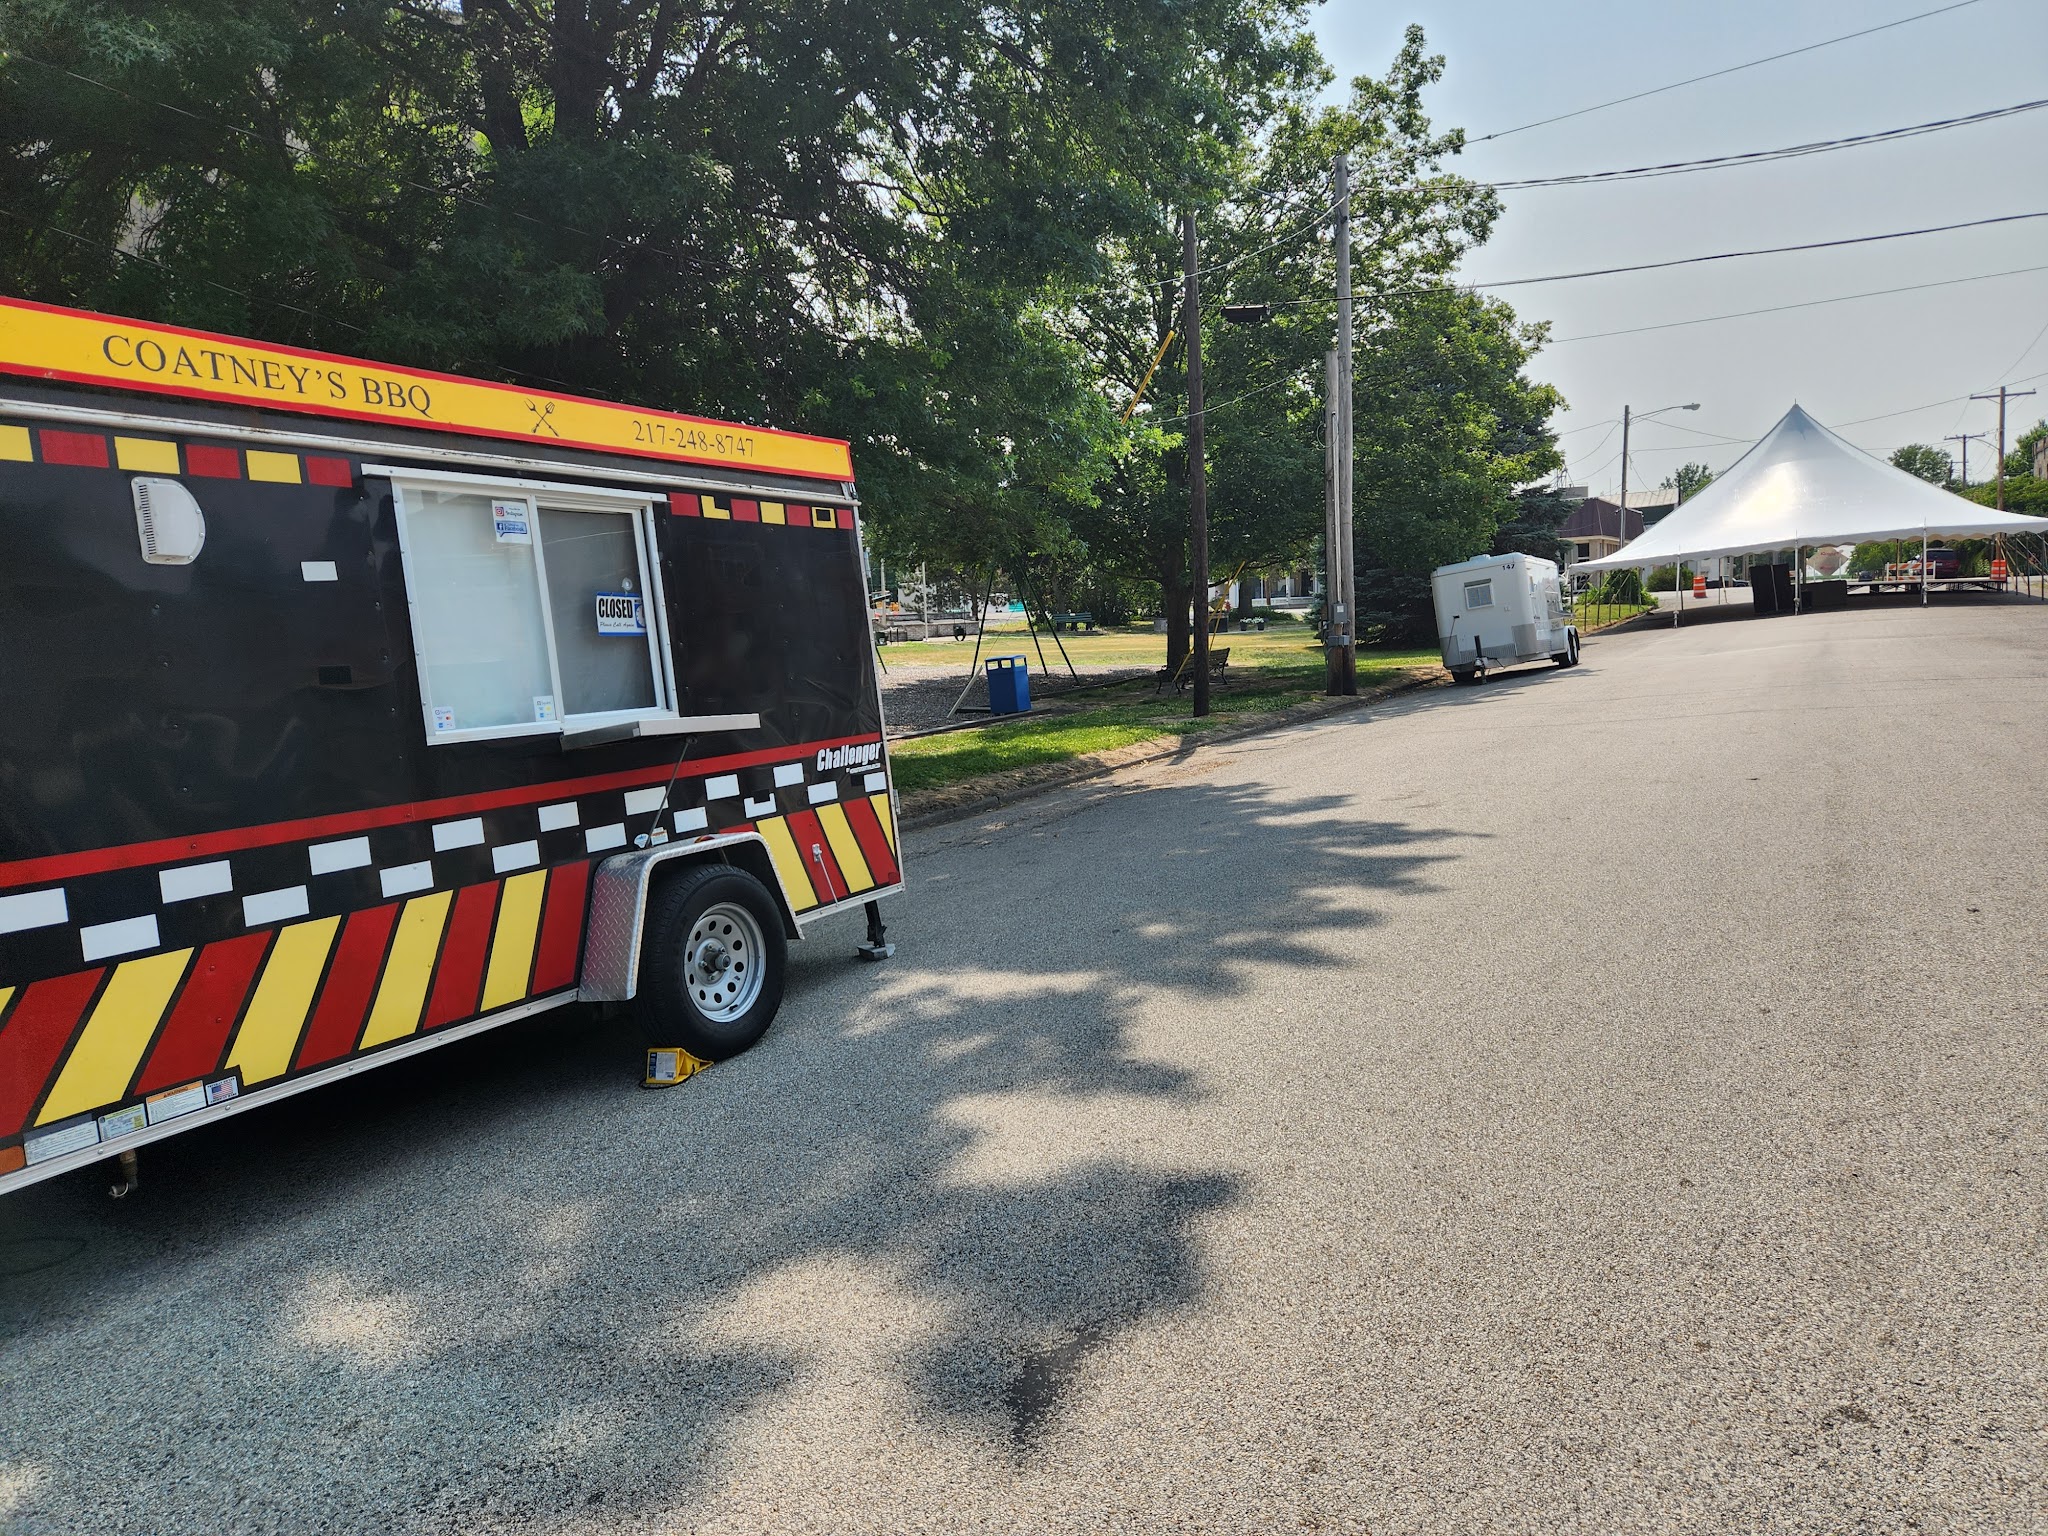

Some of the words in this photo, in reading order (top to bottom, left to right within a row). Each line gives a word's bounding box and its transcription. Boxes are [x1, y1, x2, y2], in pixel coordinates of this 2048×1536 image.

[103, 335, 346, 399] COATNEY'S
[359, 377, 433, 419] BBQ
[633, 420, 753, 457] 217-248-8747
[1502, 563, 1515, 571] 147
[599, 598, 633, 618] CLOSED
[816, 742, 882, 771] Challenger
